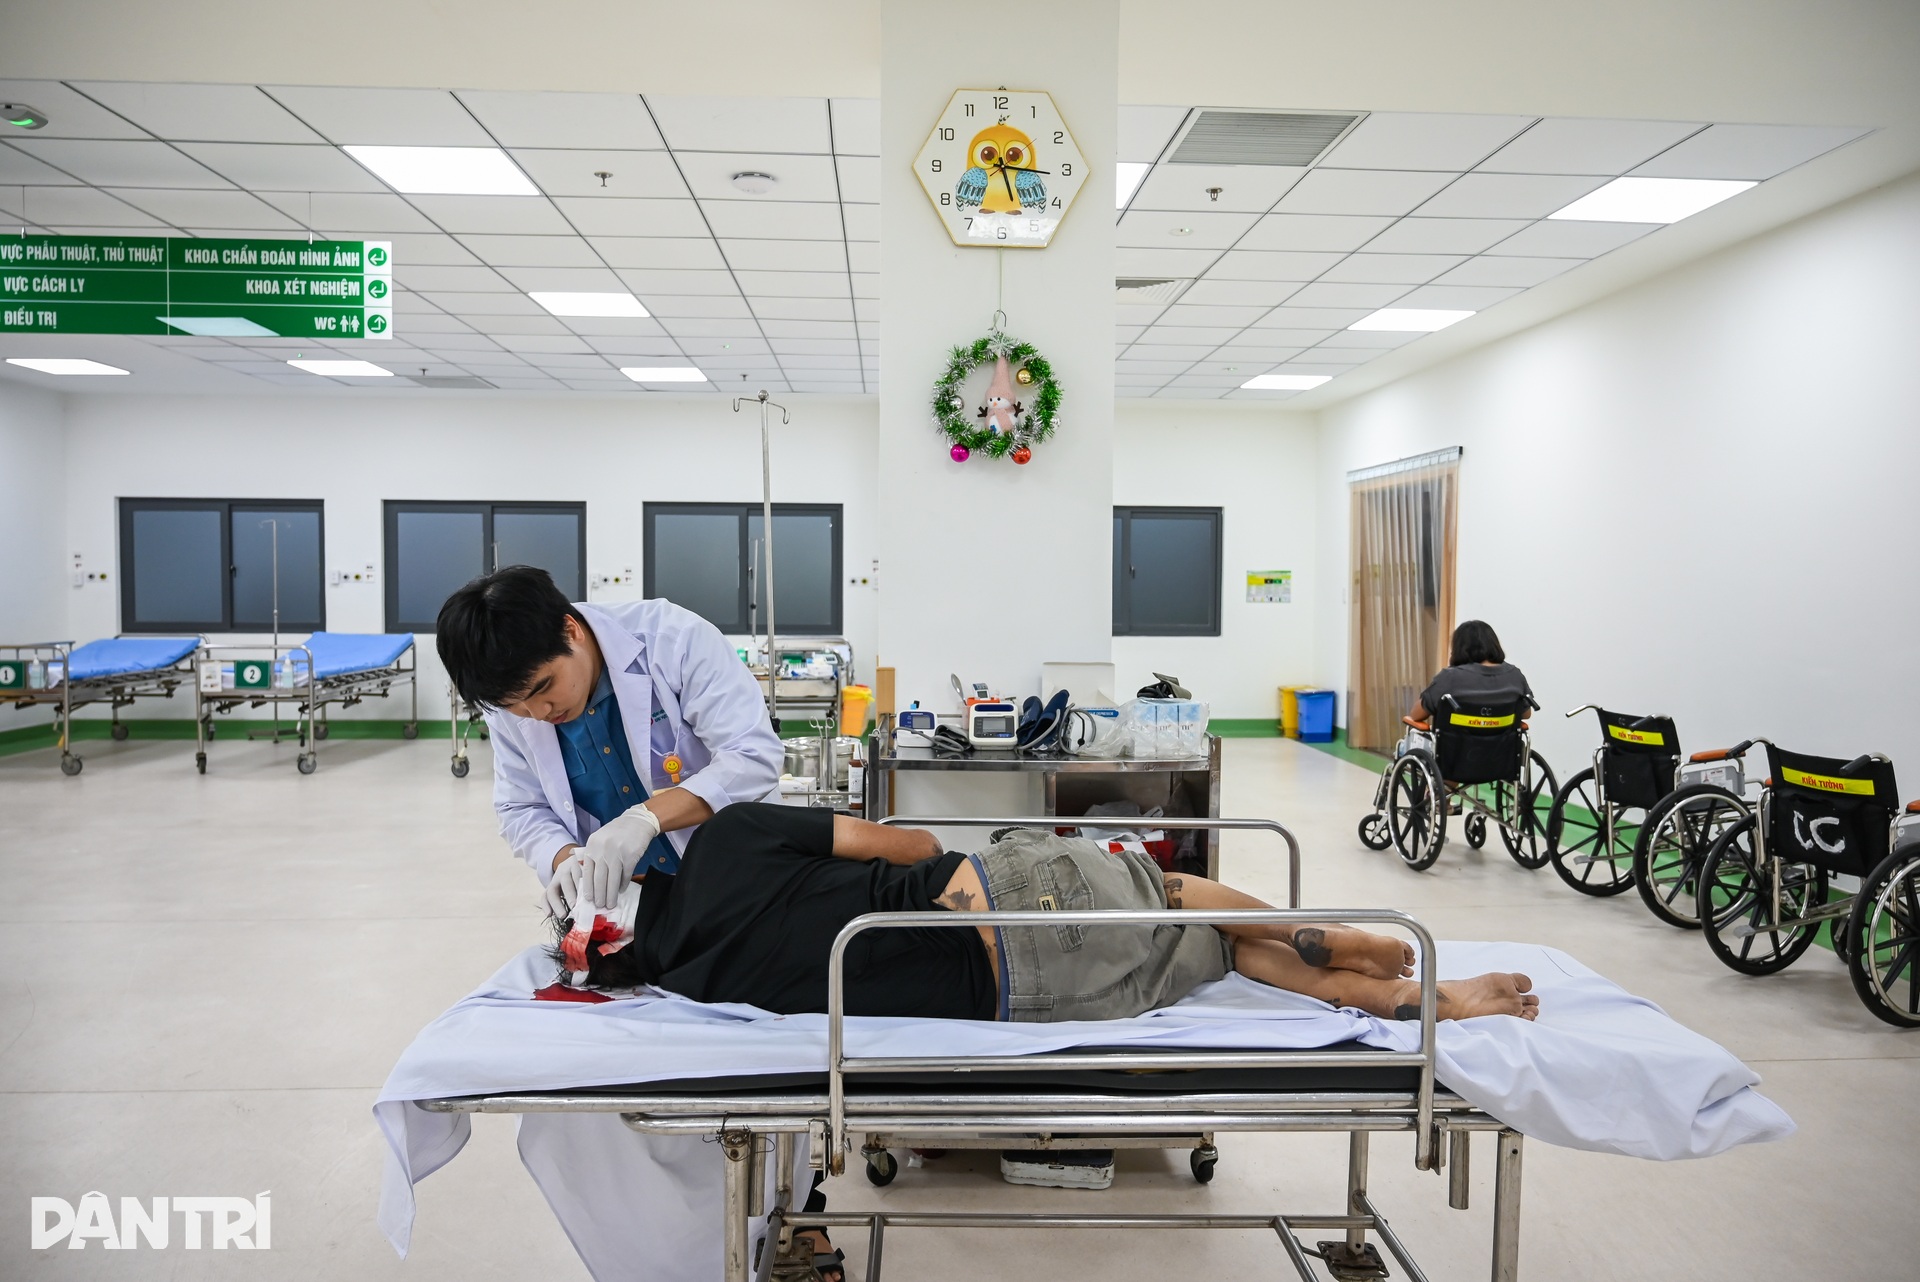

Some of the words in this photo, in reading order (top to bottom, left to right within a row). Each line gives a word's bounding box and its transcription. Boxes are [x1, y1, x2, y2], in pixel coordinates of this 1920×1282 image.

[965, 104, 975, 117] 11
[993, 97, 1009, 110] 12
[1031, 106, 1036, 119] 1
[939, 128, 955, 141] 10
[1053, 131, 1064, 144] 2
[931, 159, 942, 173] 9
[1061, 163, 1072, 177] 3
[940, 192, 951, 206] 8
[1051, 196, 1062, 210] 4
[964, 217, 974, 231] 7
[1029, 219, 1040, 232] 5
[997, 227, 1007, 240] 6
[0, 243, 23, 263] VỰC
[26, 240, 58, 261] PHẪU
[60, 243, 100, 264] THUẬT,
[103, 241, 125, 262] THỦ
[127, 244, 164, 266] THUẬT
[184, 248, 219, 264] KHOA
[222, 244, 258, 265] CHẨN
[260, 248, 296, 266] ĐOÁN
[299, 248, 330, 267] HÌNH
[333, 245, 360, 267] ẢNH
[3, 275, 29, 295] VỰC
[32, 274, 67, 293] CÁCH
[70, 278, 86, 293] LY
[246, 279, 280, 295] KHOA
[283, 277, 307, 295] XÉT
[310, 278, 360, 299] NGHIỆM
[37, 310, 57, 329] TRỊ
[314, 316, 337, 331] WC
[3, 669, 9, 681] 1
[249, 669, 256, 680] 2
